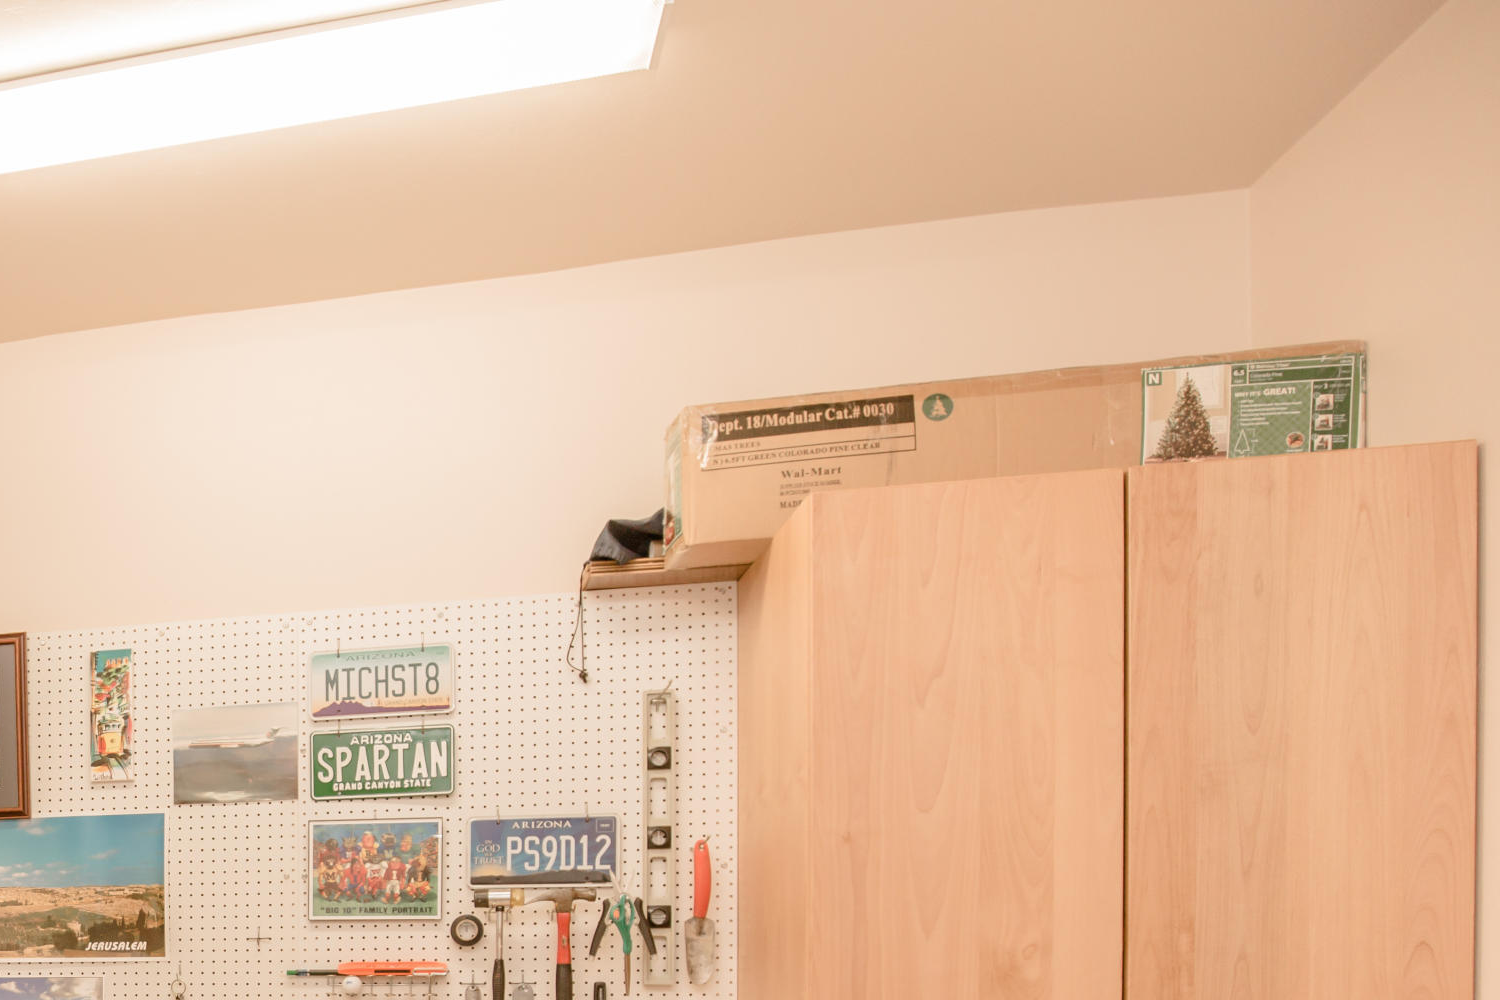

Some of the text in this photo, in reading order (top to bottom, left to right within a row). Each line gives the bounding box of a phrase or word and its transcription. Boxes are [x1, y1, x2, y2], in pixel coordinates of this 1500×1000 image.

[1148, 373, 1161, 385] N
[1263, 386, 1296, 396] GREAT!
[747, 408, 822, 430] 18/Modular
[824, 405, 861, 421] Cat.#
[863, 402, 895, 418] 0030
[748, 453, 777, 461] GREEN
[778, 447, 828, 458] COLORADO
[829, 444, 849, 452] PINE
[851, 442, 881, 451] CLEAR
[781, 466, 842, 479] Wal-Mart
[346, 651, 416, 662] ARIZONA
[325, 662, 440, 702] MICHST8
[350, 733, 413, 746] ARIZONA
[317, 740, 448, 784] SPARTAN
[333, 778, 431, 792] GRAND CANYON STATE
[512, 820, 572, 830] ARIZONA
[476, 843, 501, 854] GOD
[506, 834, 612, 872] PS9D12
[474, 856, 505, 866] TRUST
[359, 906, 389, 914] FAMILY
[392, 906, 434, 914] PORTRAIT
[85, 941, 148, 952] JERUSALEM
